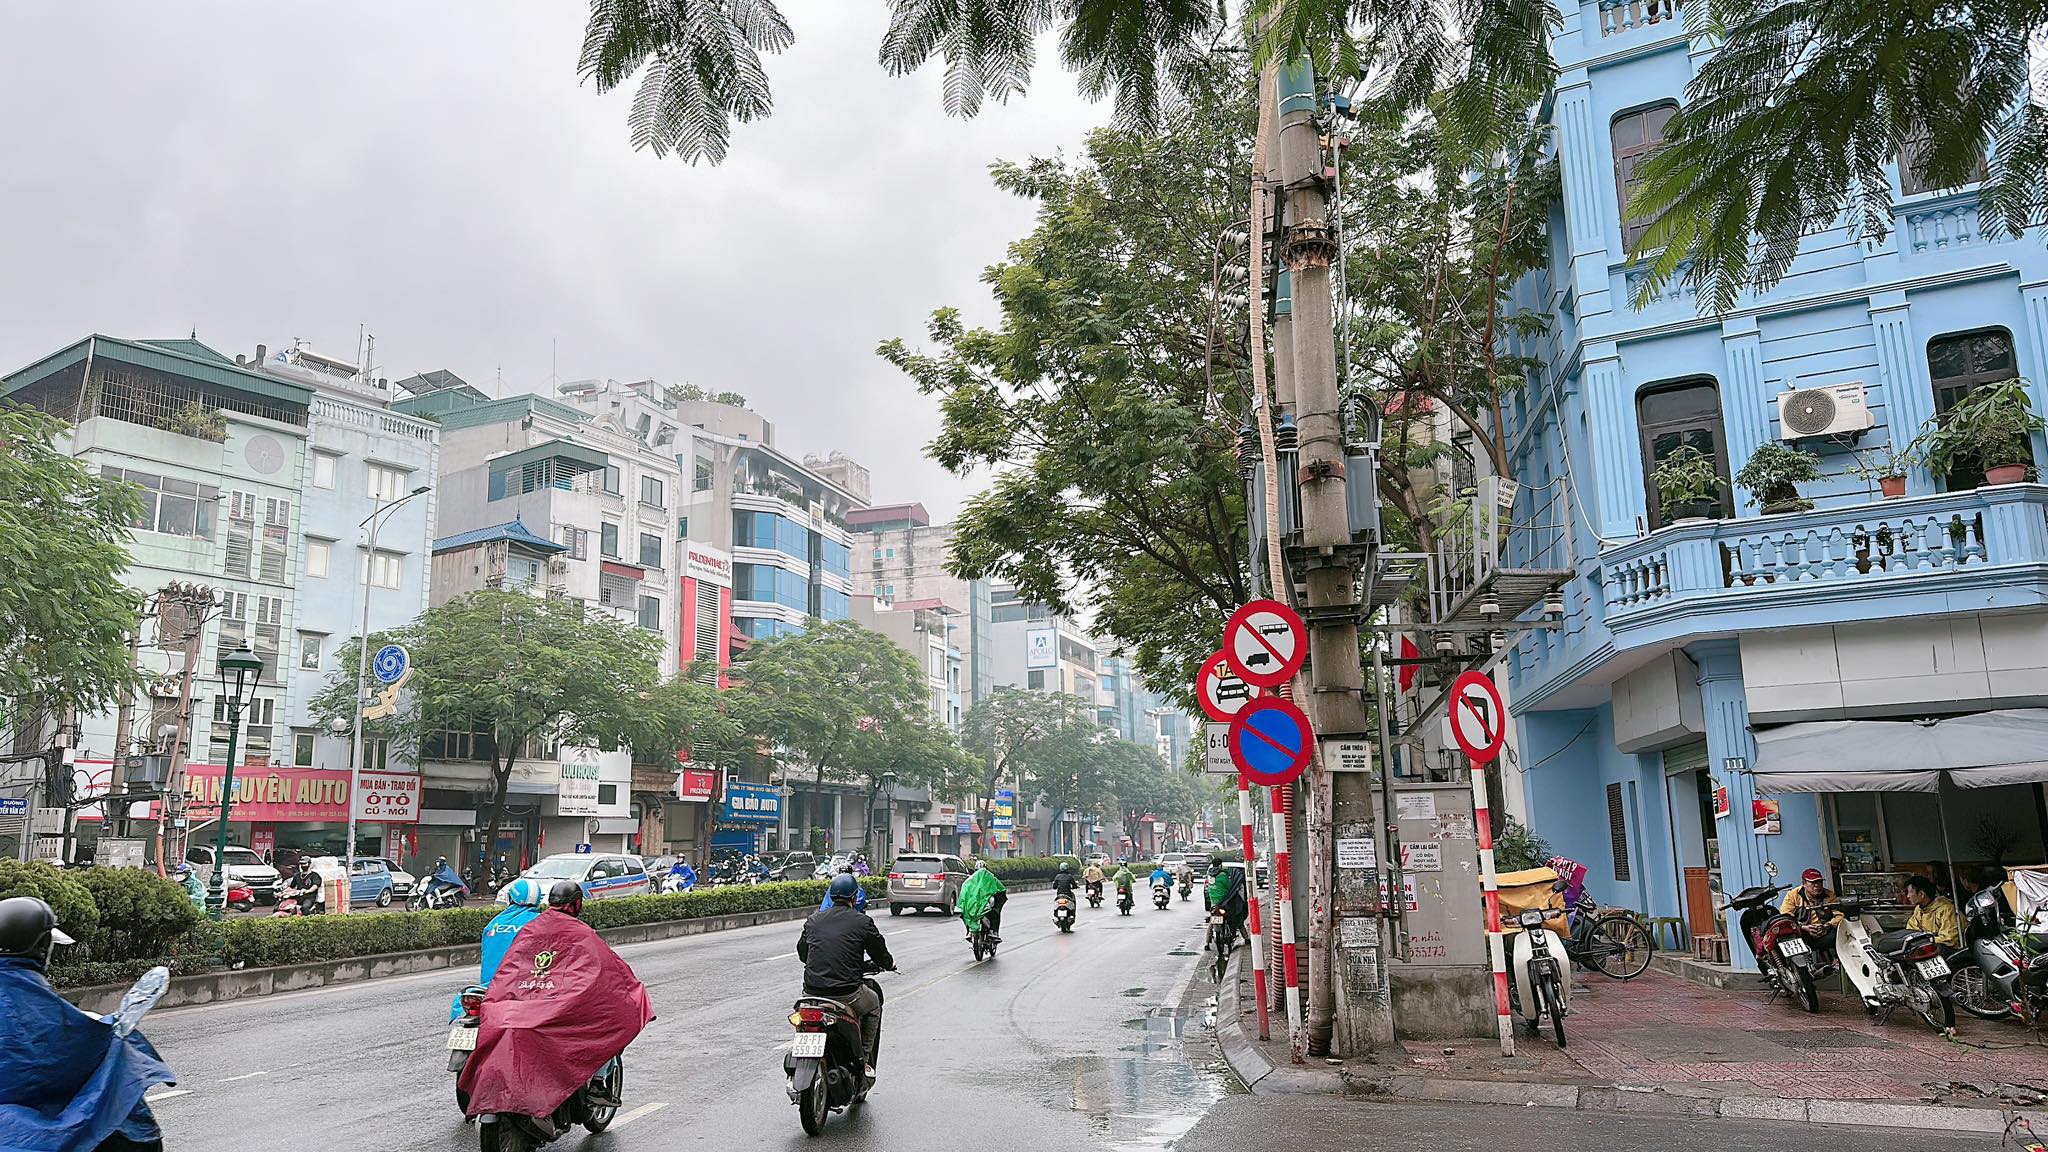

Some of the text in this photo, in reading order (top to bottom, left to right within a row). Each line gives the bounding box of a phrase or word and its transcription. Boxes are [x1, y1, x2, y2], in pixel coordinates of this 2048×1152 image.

[1726, 759, 1744, 769] 111
[360, 780, 373, 790] MUA
[374, 778, 387, 790] BÁN
[391, 781, 405, 790] TRAO
[298, 779, 347, 805] AUTO
[760, 799, 778, 811] AUTO
[365, 807, 380, 815] CŨ
[388, 807, 408, 815] MỚI
[1925, 966, 1947, 978] 6550
[799, 1035, 821, 1045] 29-F1
[795, 1045, 822, 1055] 559.36
